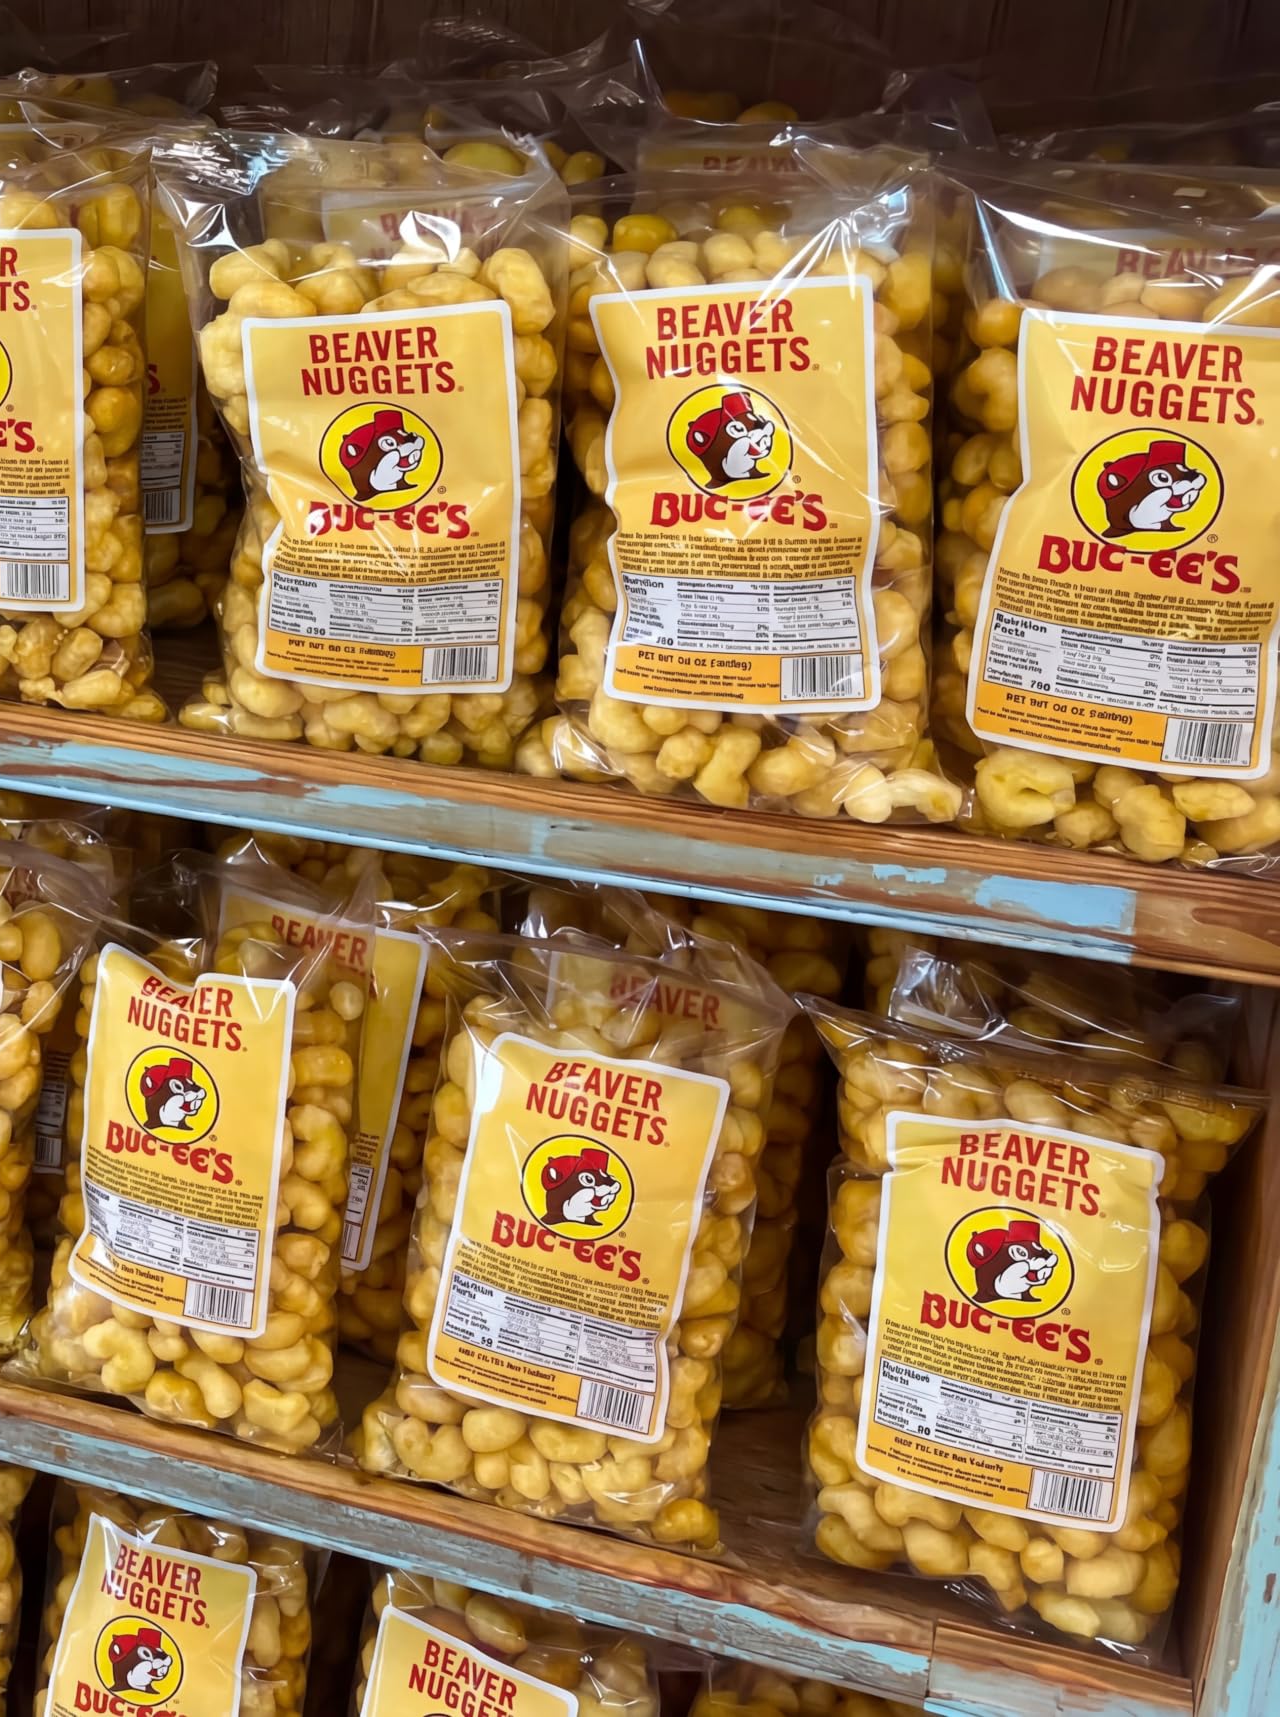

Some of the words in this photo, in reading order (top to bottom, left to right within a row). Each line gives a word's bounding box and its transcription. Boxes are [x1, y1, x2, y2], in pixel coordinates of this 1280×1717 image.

[657, 299, 793, 340] BEAVER
[309, 326, 438, 364] BEAVER
[646, 336, 810, 380] NUGGETS
[1092, 336, 1242, 383] BEAVER
[301, 361, 455, 396] NUGGETS
[1071, 376, 1255, 425] NUGGETS
[1038, 535, 1240, 594] BUC-EE'S
[128, 997, 241, 1051] NUGGETS
[544, 1062, 662, 1111] BEAVER
[526, 1083, 667, 1145] NUGGETS
[106, 1120, 233, 1184] BUC-EE'S
[960, 1133, 1089, 1178] BEAVER
[941, 1156, 1100, 1216] NUGGETS
[491, 1211, 641, 1282] BUC-EE'S
[920, 1291, 1091, 1364] BUC-EE'S
[116, 1545, 201, 1595] BEAVER
[102, 1576, 207, 1626] NUGGETS
[408, 1663, 514, 1717] NUGGE
[424, 1640, 517, 1710] BEAVER
